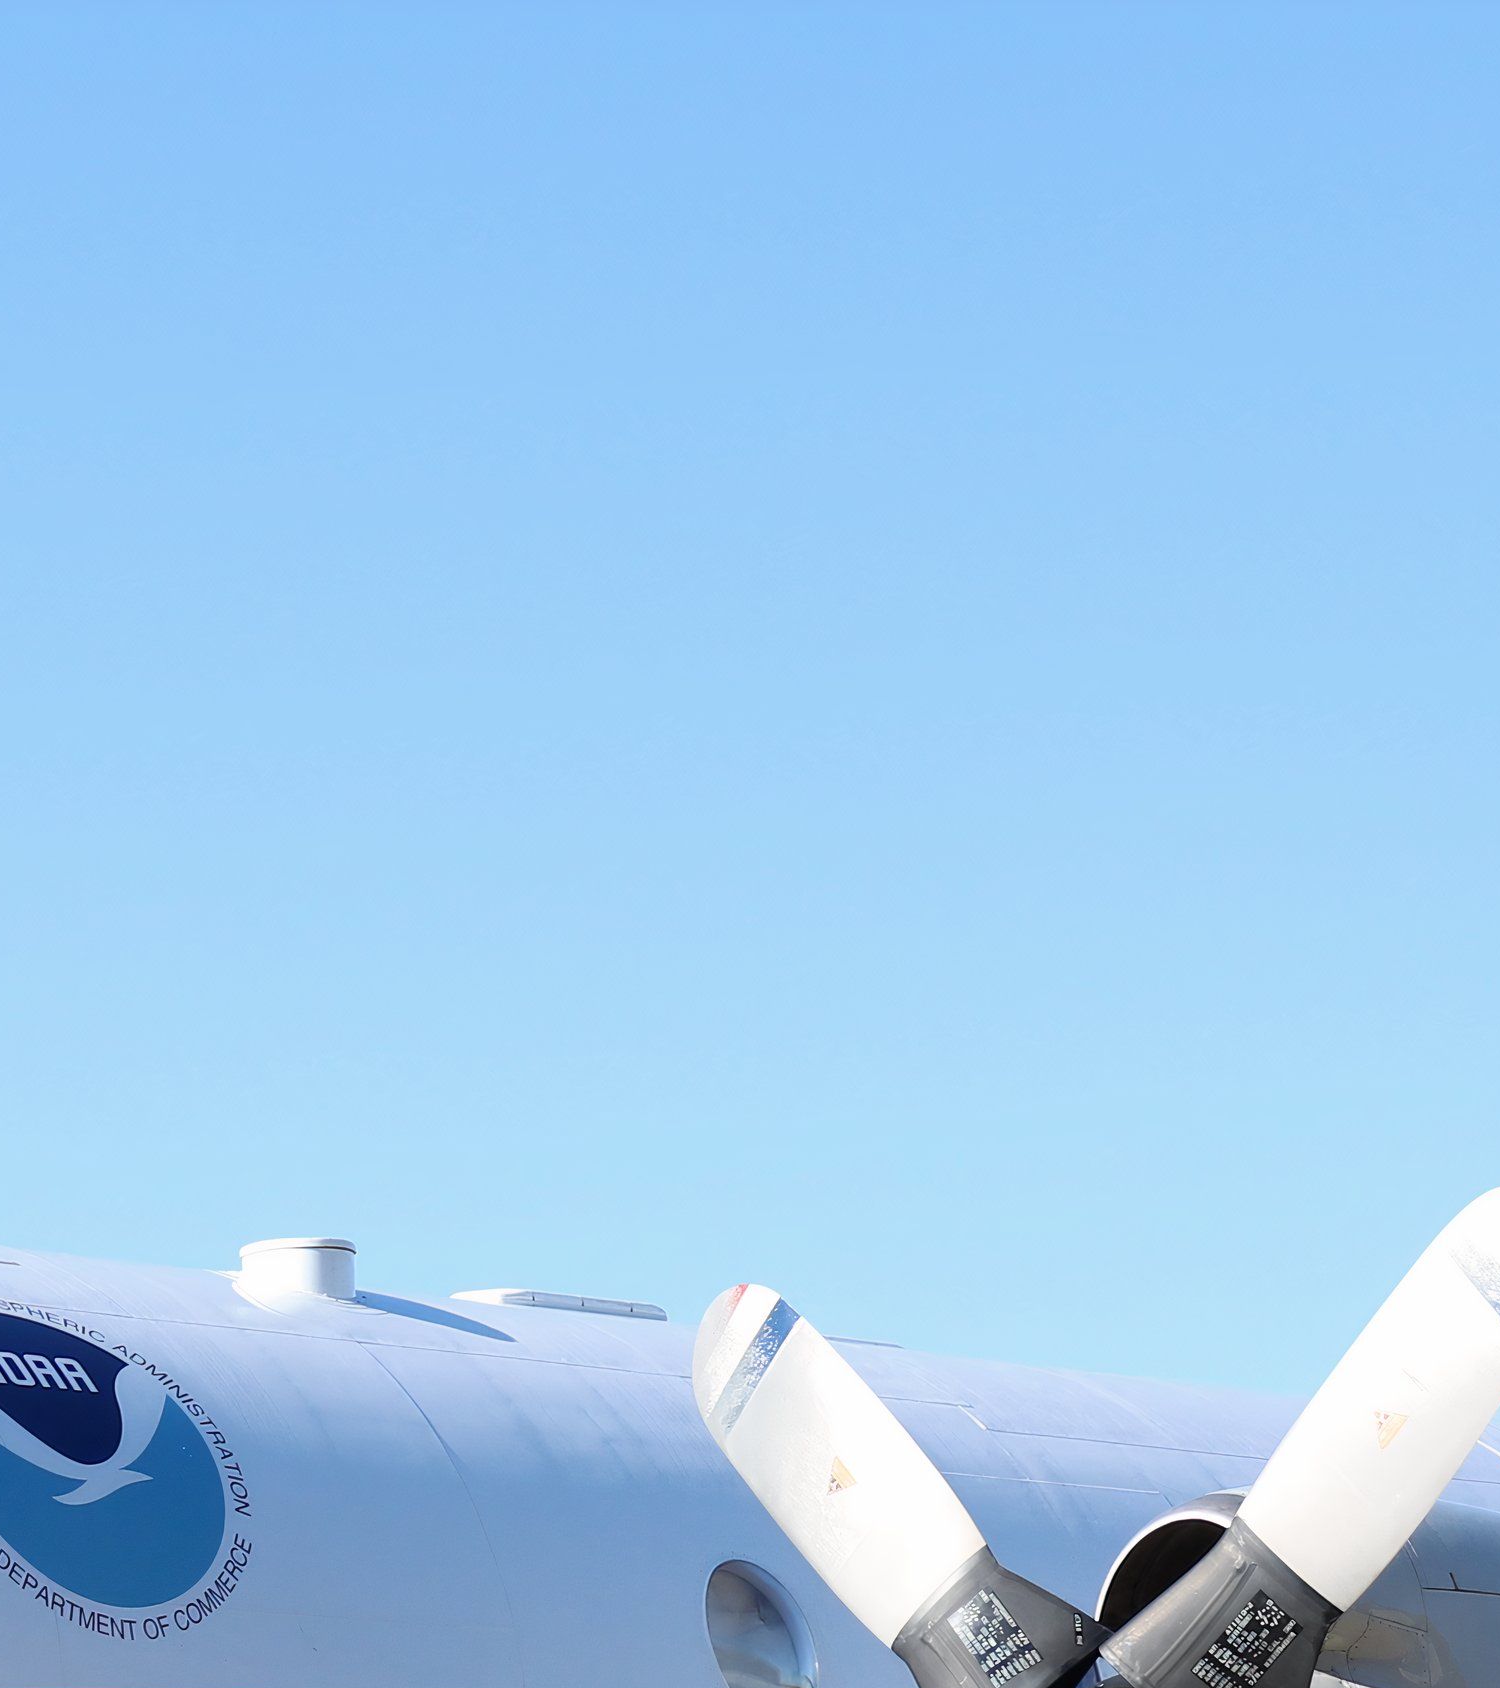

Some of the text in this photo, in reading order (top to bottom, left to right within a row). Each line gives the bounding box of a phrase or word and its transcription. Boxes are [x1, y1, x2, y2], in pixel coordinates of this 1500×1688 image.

[112, 1343, 253, 1517] ADMINISTRATION
[141, 1614, 170, 1640] OF
[172, 1532, 253, 1632] COMMERCE
